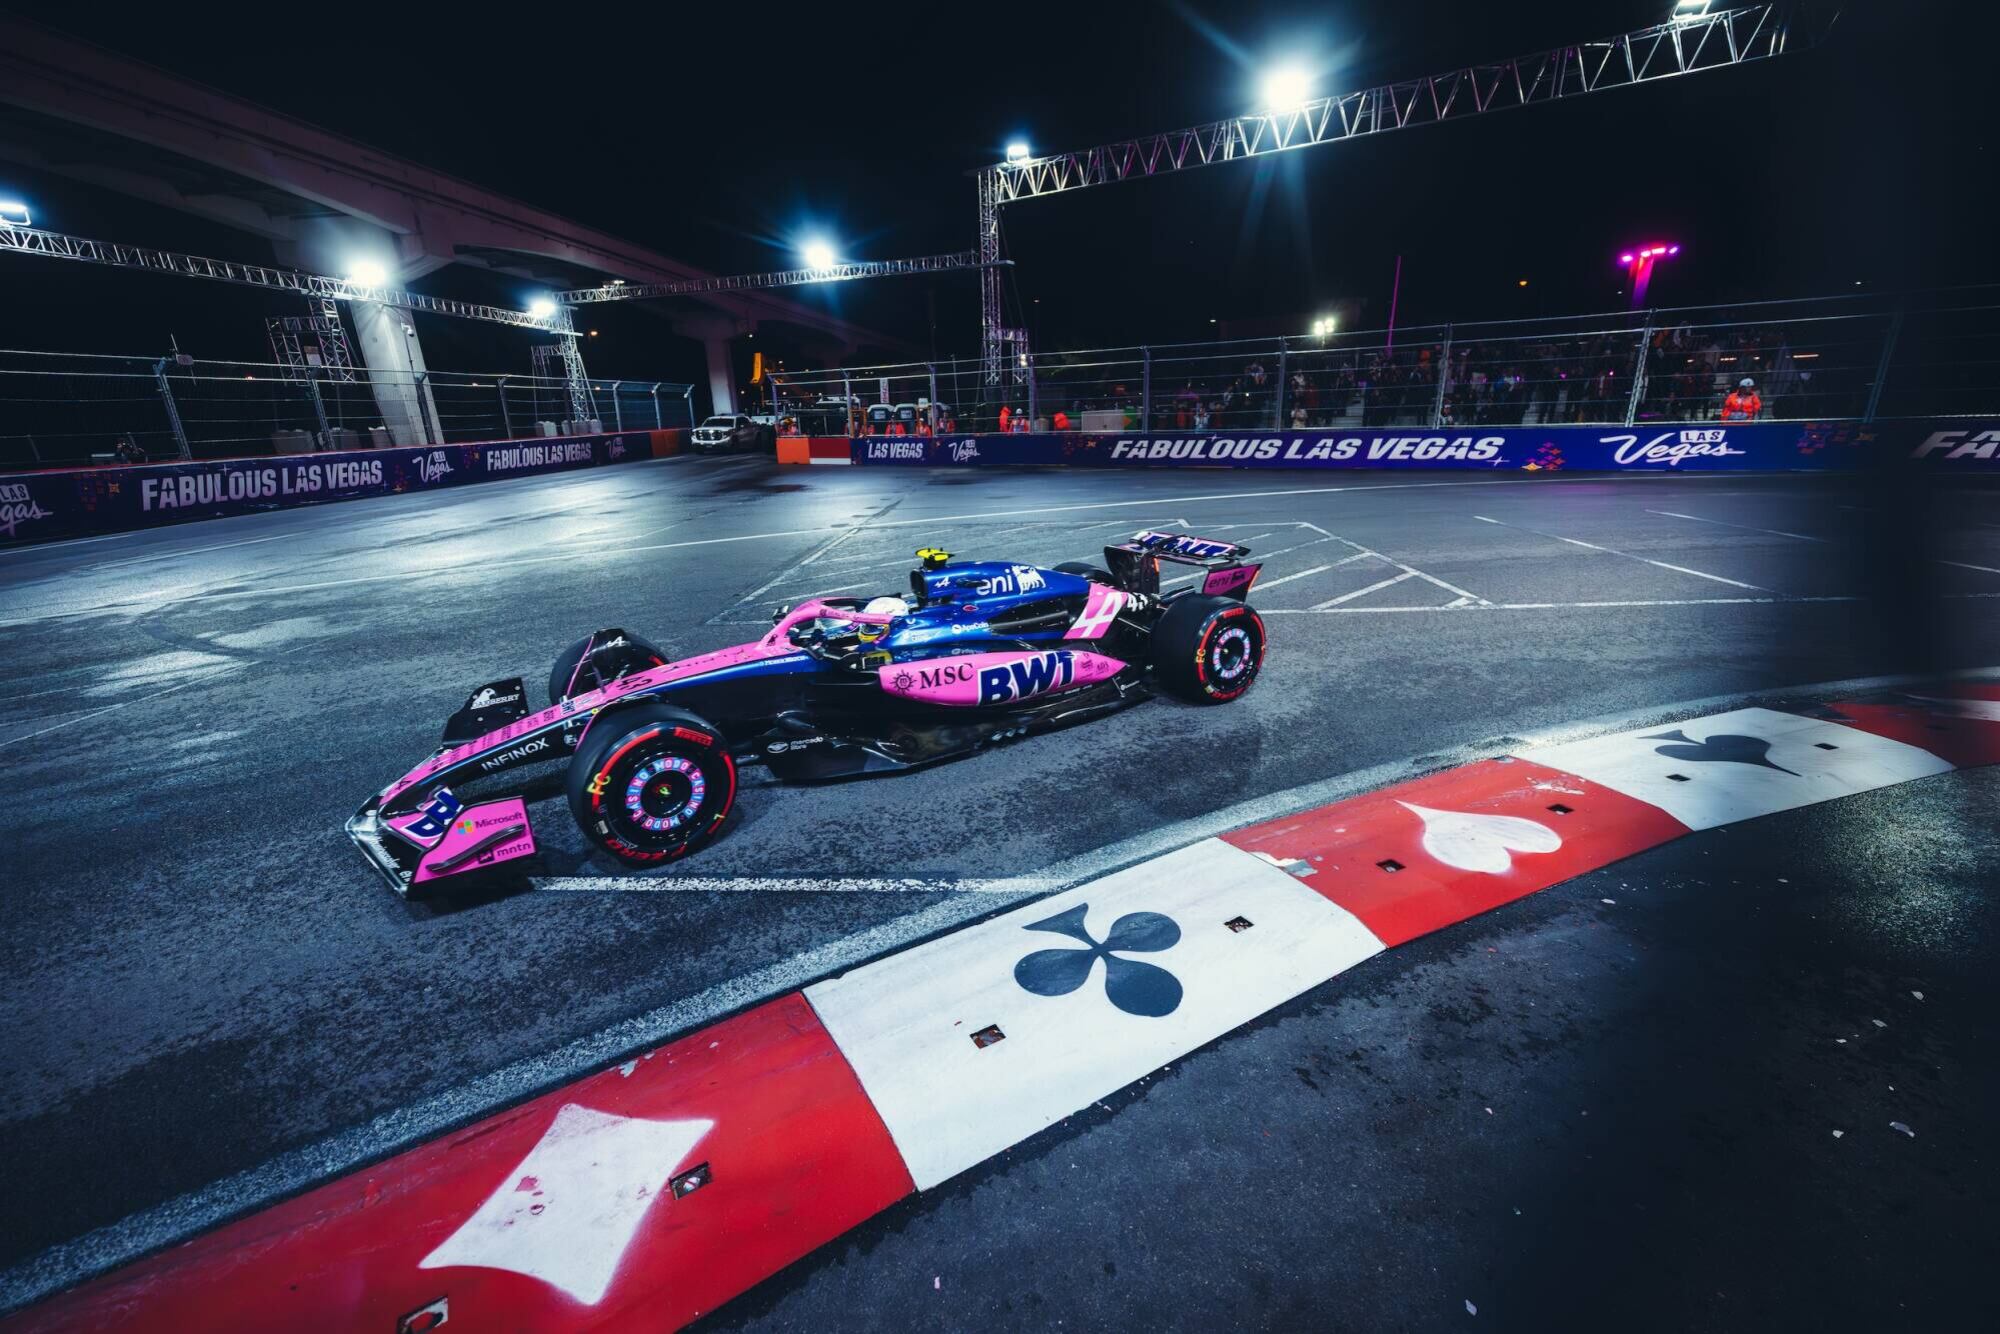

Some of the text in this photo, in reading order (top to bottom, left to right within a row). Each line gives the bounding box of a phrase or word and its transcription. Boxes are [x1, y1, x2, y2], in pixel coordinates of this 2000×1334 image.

[1110, 436, 1506, 460] FABULOUS LAS VEGAS
[1599, 432, 1746, 466] Vegas
[1685, 431, 1721, 441] LAS
[487, 442, 592, 471] FABULOUS LAS VEGAS
[867, 442, 924, 459] LAS VEGAS
[948, 441, 981, 462] Vegas
[412, 453, 454, 483] Vegas
[141, 459, 383, 512] FABULOUS LAS VEGAS
[0, 500, 54, 537] gas
[976, 568, 1013, 596] eni
[919, 663, 974, 690] MSC
[978, 651, 1076, 706] BWT
[481, 737, 550, 771] INFINOX
[475, 812, 523, 828] Microsoft
[496, 843, 531, 857] mntn
